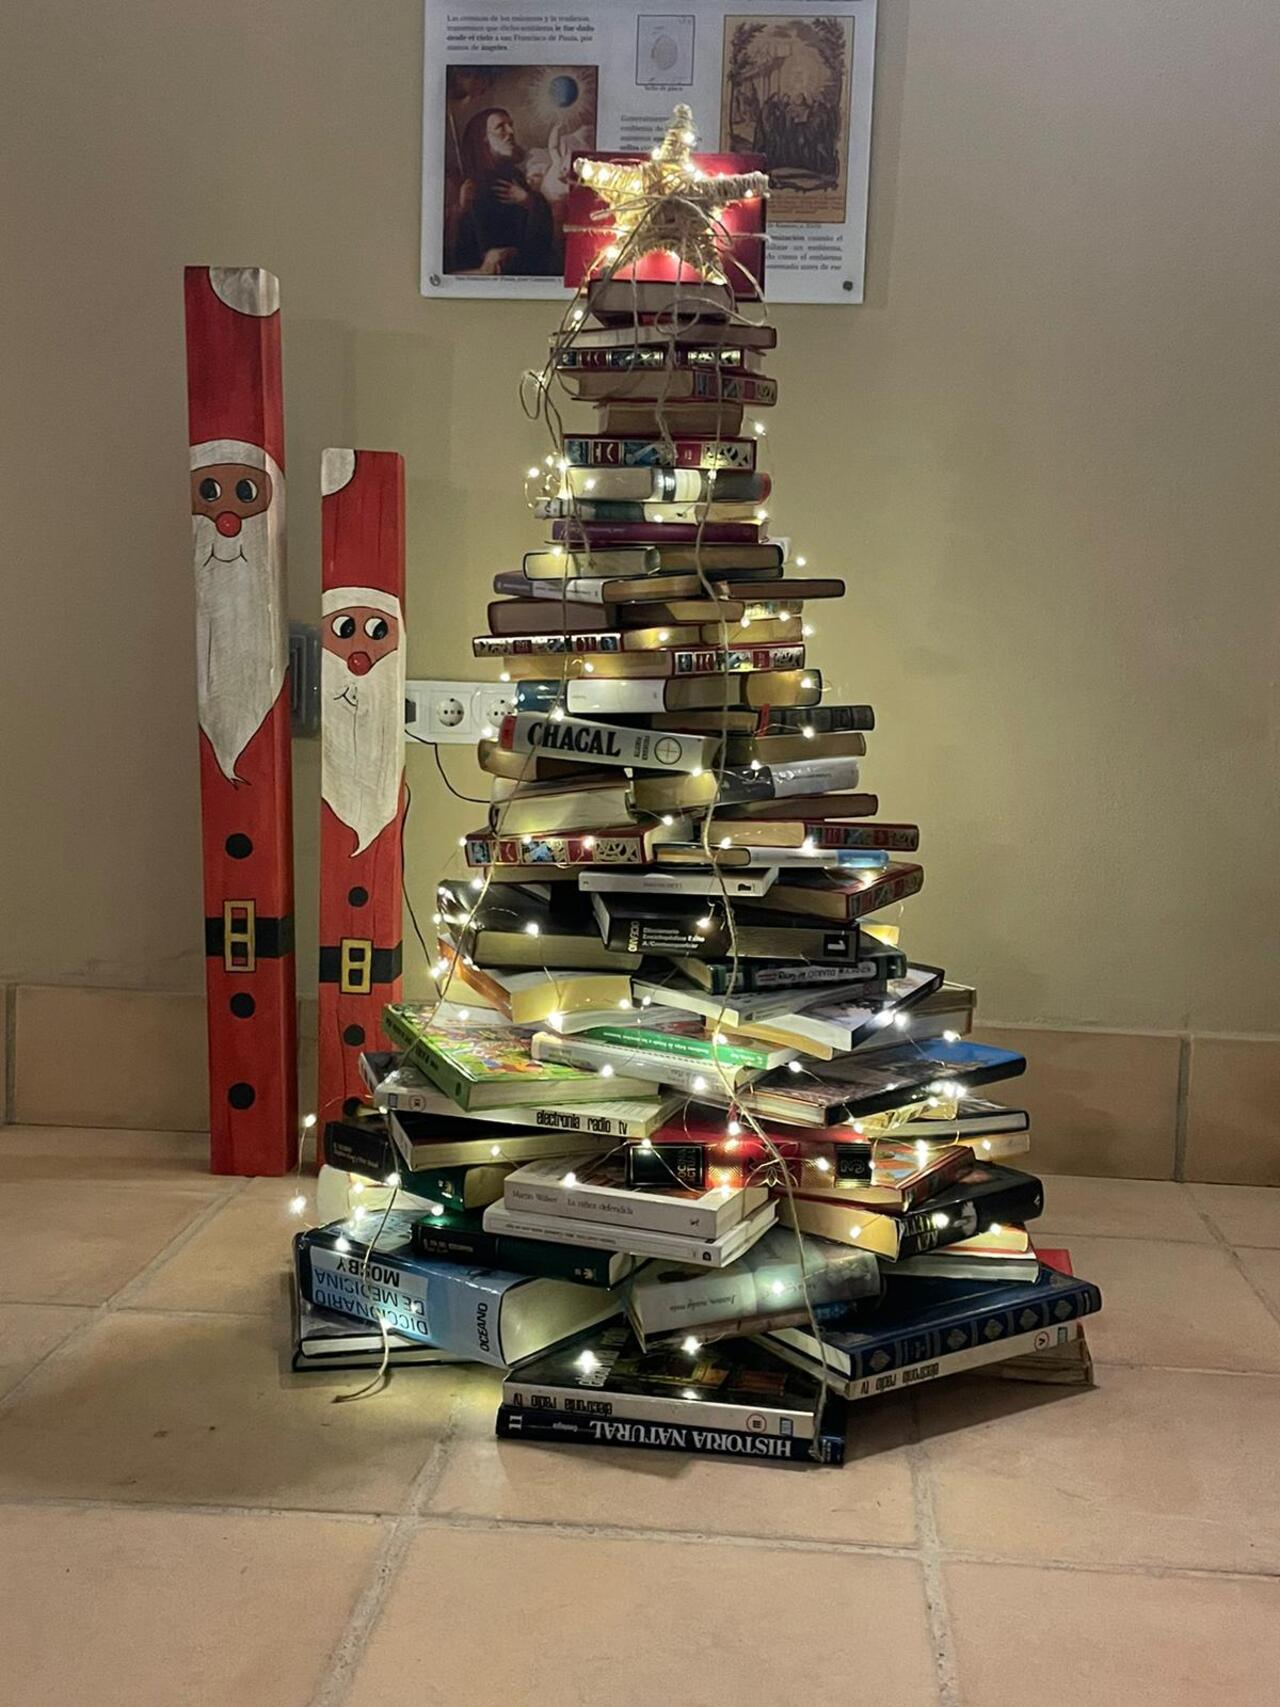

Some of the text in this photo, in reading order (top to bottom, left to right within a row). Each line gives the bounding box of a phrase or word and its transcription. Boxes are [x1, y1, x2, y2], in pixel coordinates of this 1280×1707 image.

[527, 722, 621, 757] CHACAL
[627, 920, 640, 952] OCEANO
[587, 1117, 611, 1133] radio
[618, 1120, 628, 1134] tv
[337, 1256, 401, 1288] MOSBY
[315, 1268, 425, 1317] DE MEDICINA
[315, 1289, 429, 1335] DICCIONARIO
[477, 1301, 490, 1353] OCEANO
[860, 1380, 870, 1395] tv
[875, 1373, 897, 1391] radio
[513, 1393, 524, 1406] tv
[531, 1395, 557, 1409] radio
[589, 1419, 689, 1448] NATURAL
[693, 1434, 793, 1458] HISTORIA
